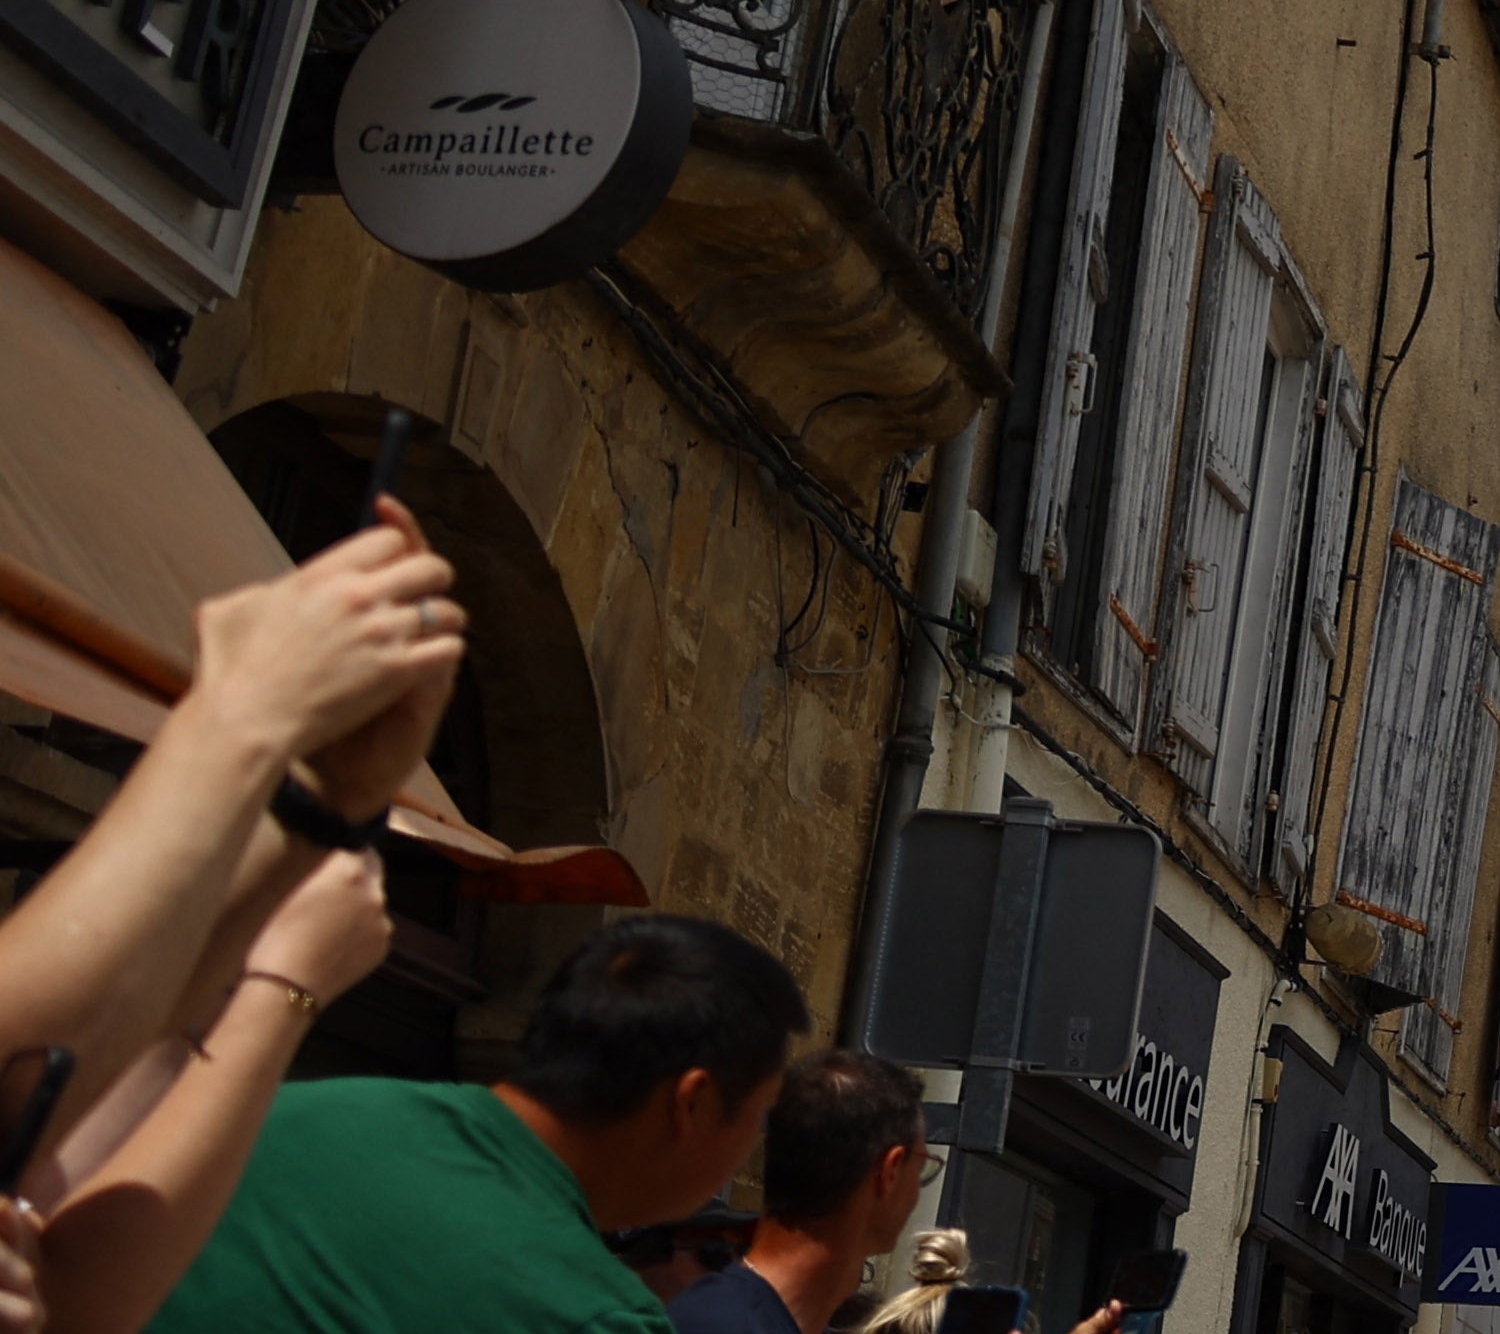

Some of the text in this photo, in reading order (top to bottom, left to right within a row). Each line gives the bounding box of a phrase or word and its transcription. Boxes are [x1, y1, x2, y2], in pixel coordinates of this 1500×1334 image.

[359, 124, 594, 160] Campaillette
[388, 164, 548, 178] ARTISAN BOULANGER
[1311, 1123, 1427, 1289] AXA Banque
